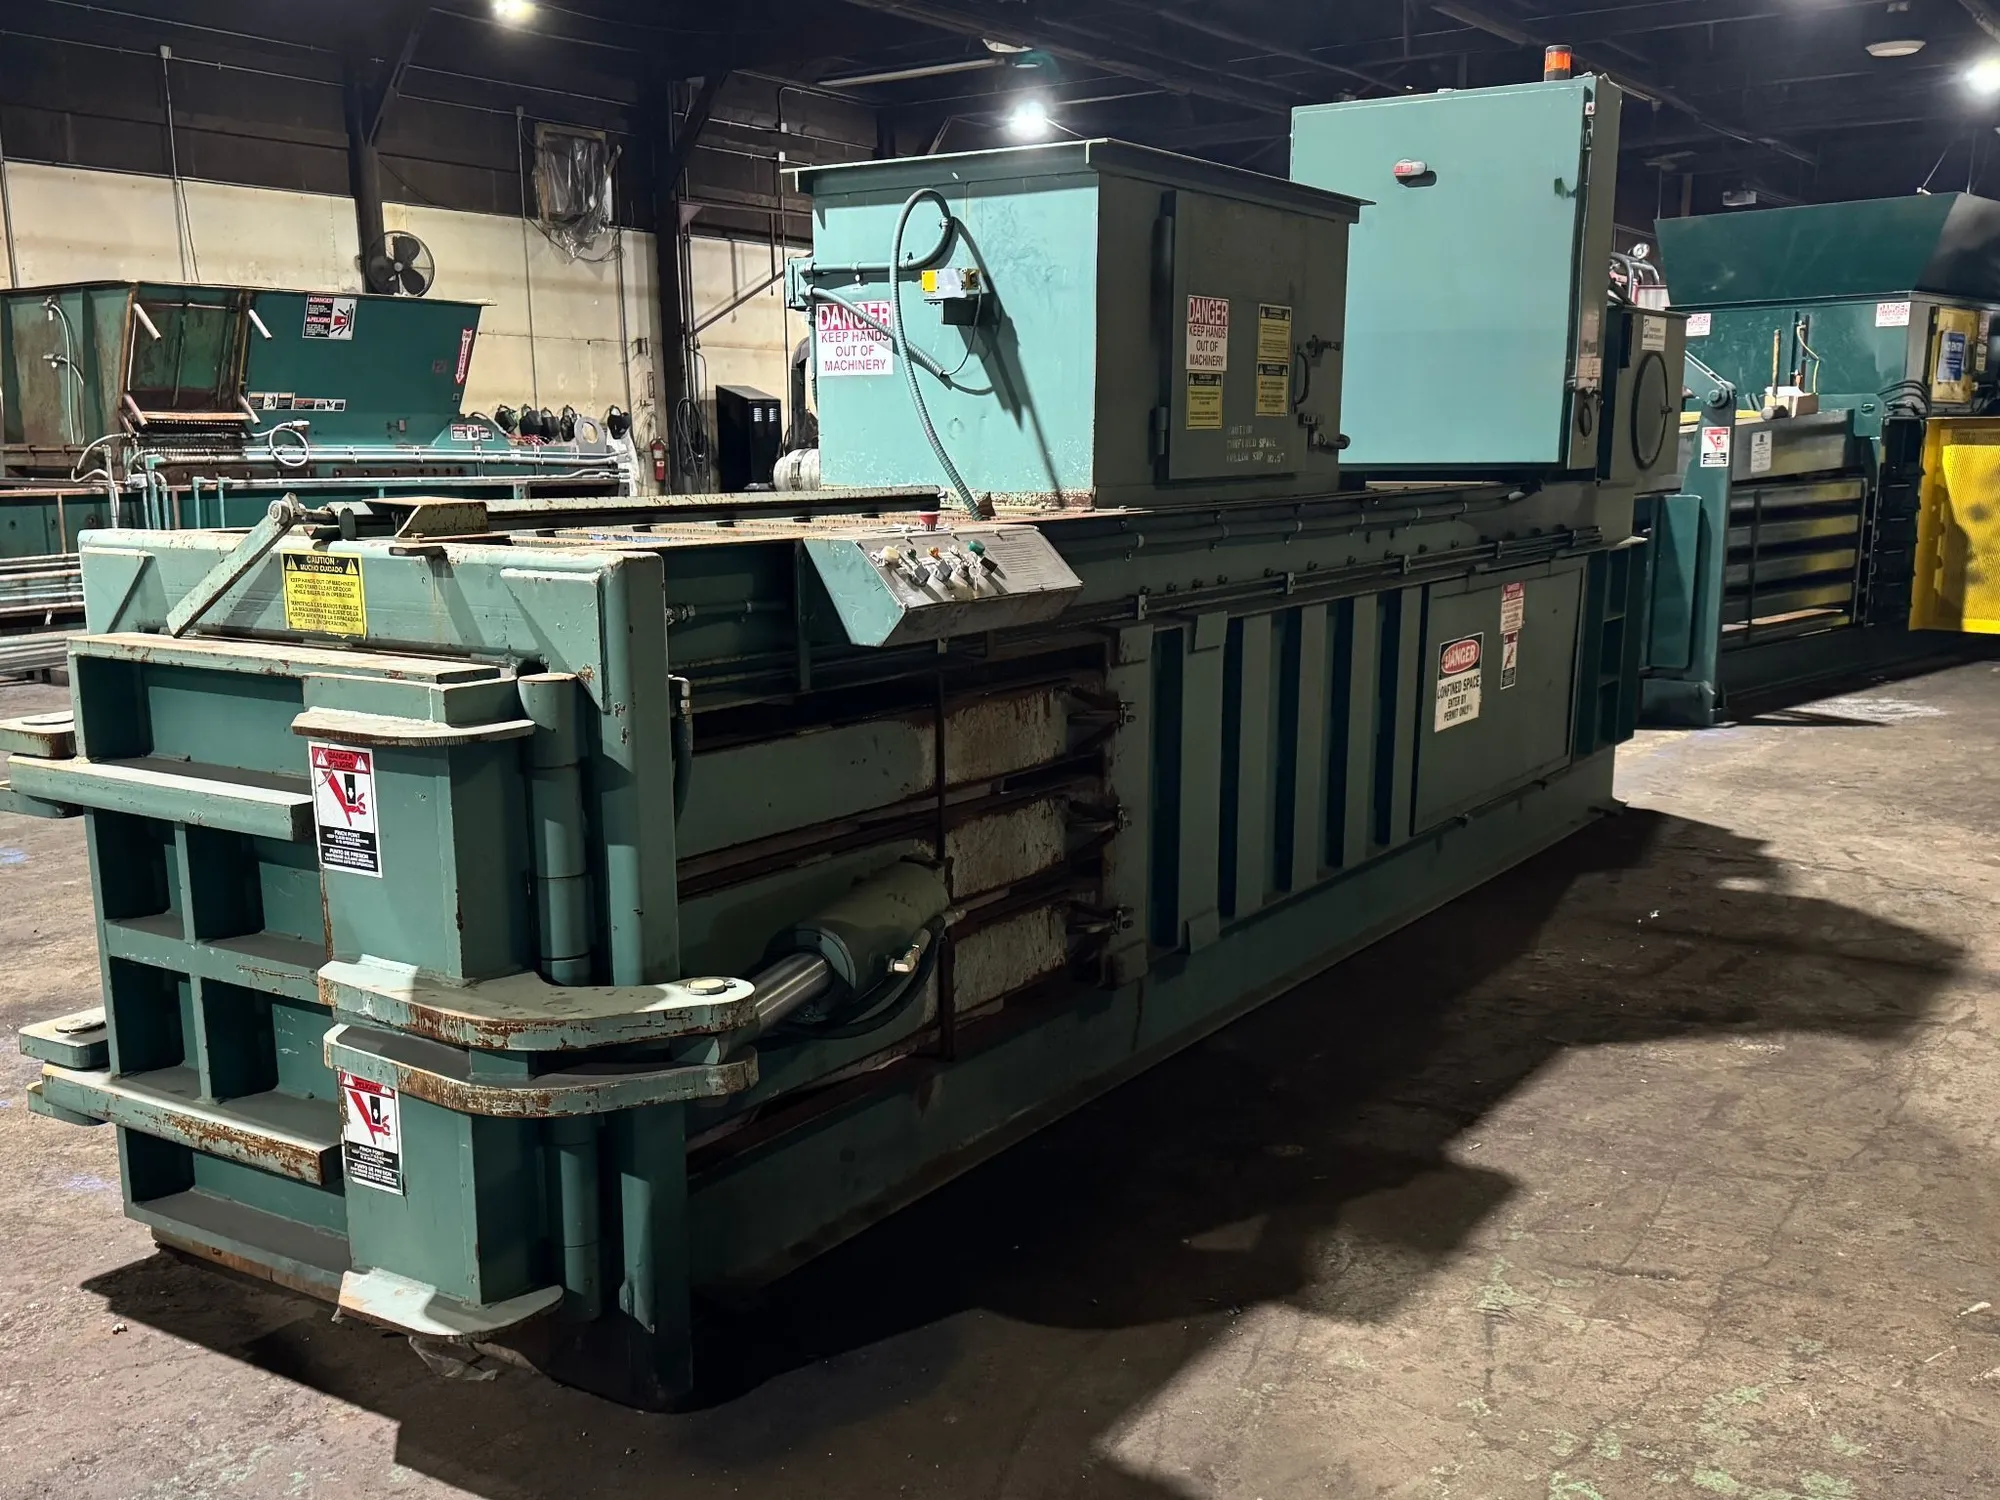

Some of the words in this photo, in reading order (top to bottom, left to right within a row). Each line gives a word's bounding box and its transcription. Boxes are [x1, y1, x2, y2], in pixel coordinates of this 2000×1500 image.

[819, 303, 891, 330] DANGER
[1188, 297, 1228, 325] DANGER
[821, 332, 848, 343] KEEP
[852, 330, 888, 342] HANDS
[1189, 325, 1204, 337] KEEP
[1205, 326, 1226, 338] HANDS
[836, 345, 857, 357] OUT
[860, 344, 874, 356] OF
[1196, 340, 1209, 352] OUT
[1210, 340, 1218, 352] OF
[824, 358, 886, 372] MACHINERY
[1190, 354, 1224, 367] MACHINERY
[306, 556, 334, 566] CAUTION
[300, 564, 318, 572] MUCHO
[1444, 644, 1476, 669] DANGER
[1437, 679, 1462, 700] CONFINED
[1463, 675, 1480, 692] SPACE
[1448, 696, 1460, 709] ENTER
[1460, 694, 1467, 706] BY
[1444, 708, 1458, 722] PERMIT
[328, 751, 352, 760] DANGER
[329, 848, 343, 856] PUNTO
